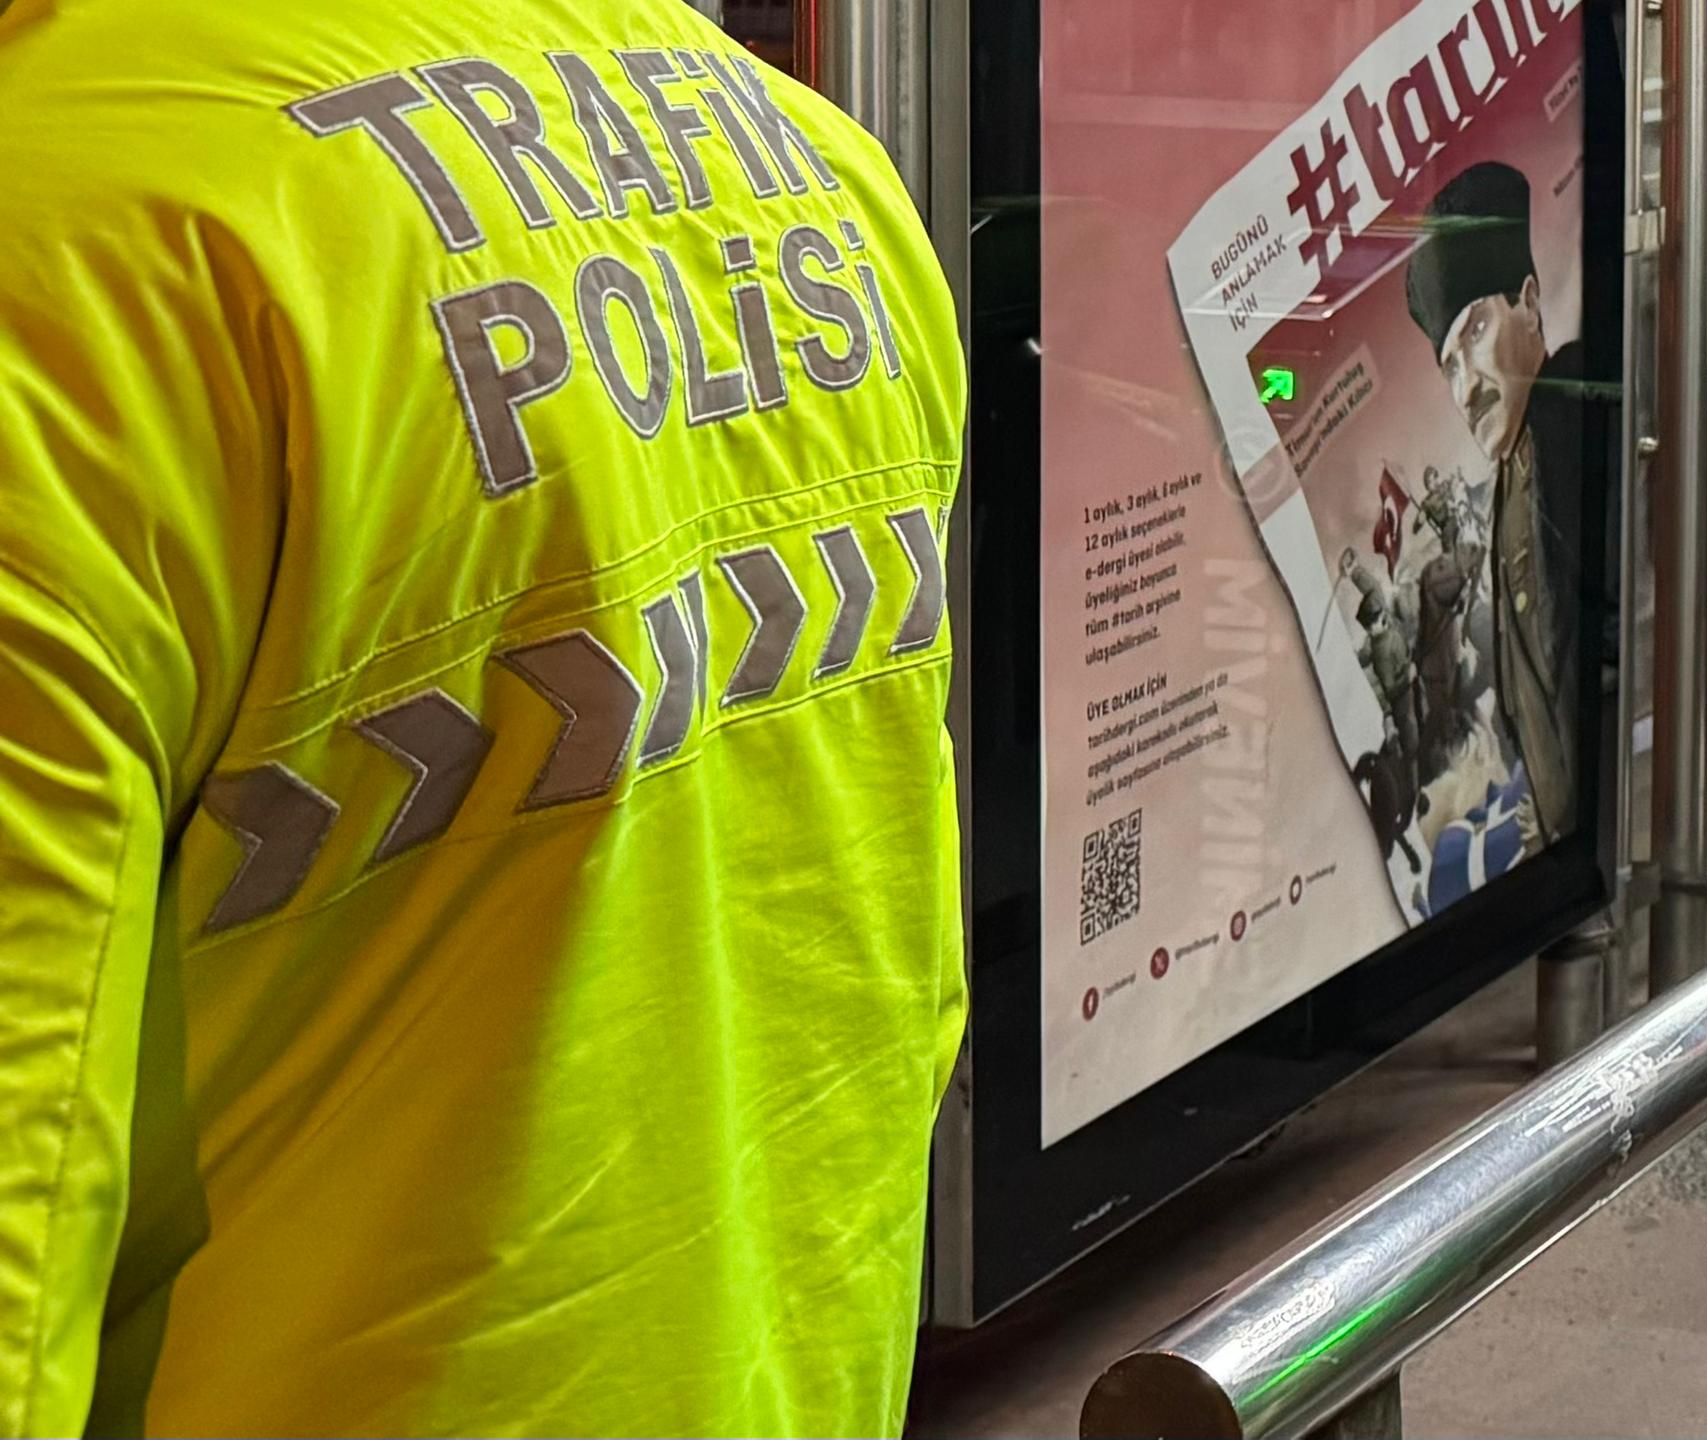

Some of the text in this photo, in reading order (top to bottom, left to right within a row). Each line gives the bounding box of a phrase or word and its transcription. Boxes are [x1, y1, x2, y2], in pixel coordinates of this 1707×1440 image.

[281, 44, 840, 255] TRAFİK
[1210, 214, 1270, 280] BUGÜNÜ
[1220, 234, 1289, 307] ANLAMAK
[1228, 292, 1259, 332] İÇİN
[428, 217, 903, 499] POLİSİ
[1084, 506, 1090, 524] 1
[1127, 495, 1134, 511] 3
[1085, 533, 1099, 552] 12
[1101, 526, 1128, 549] aylık
[1085, 552, 1127, 581] e-dergi
[1112, 603, 1144, 627] #tarih
[1087, 672, 1168, 722] ÜYE OLMAK İÇİN
